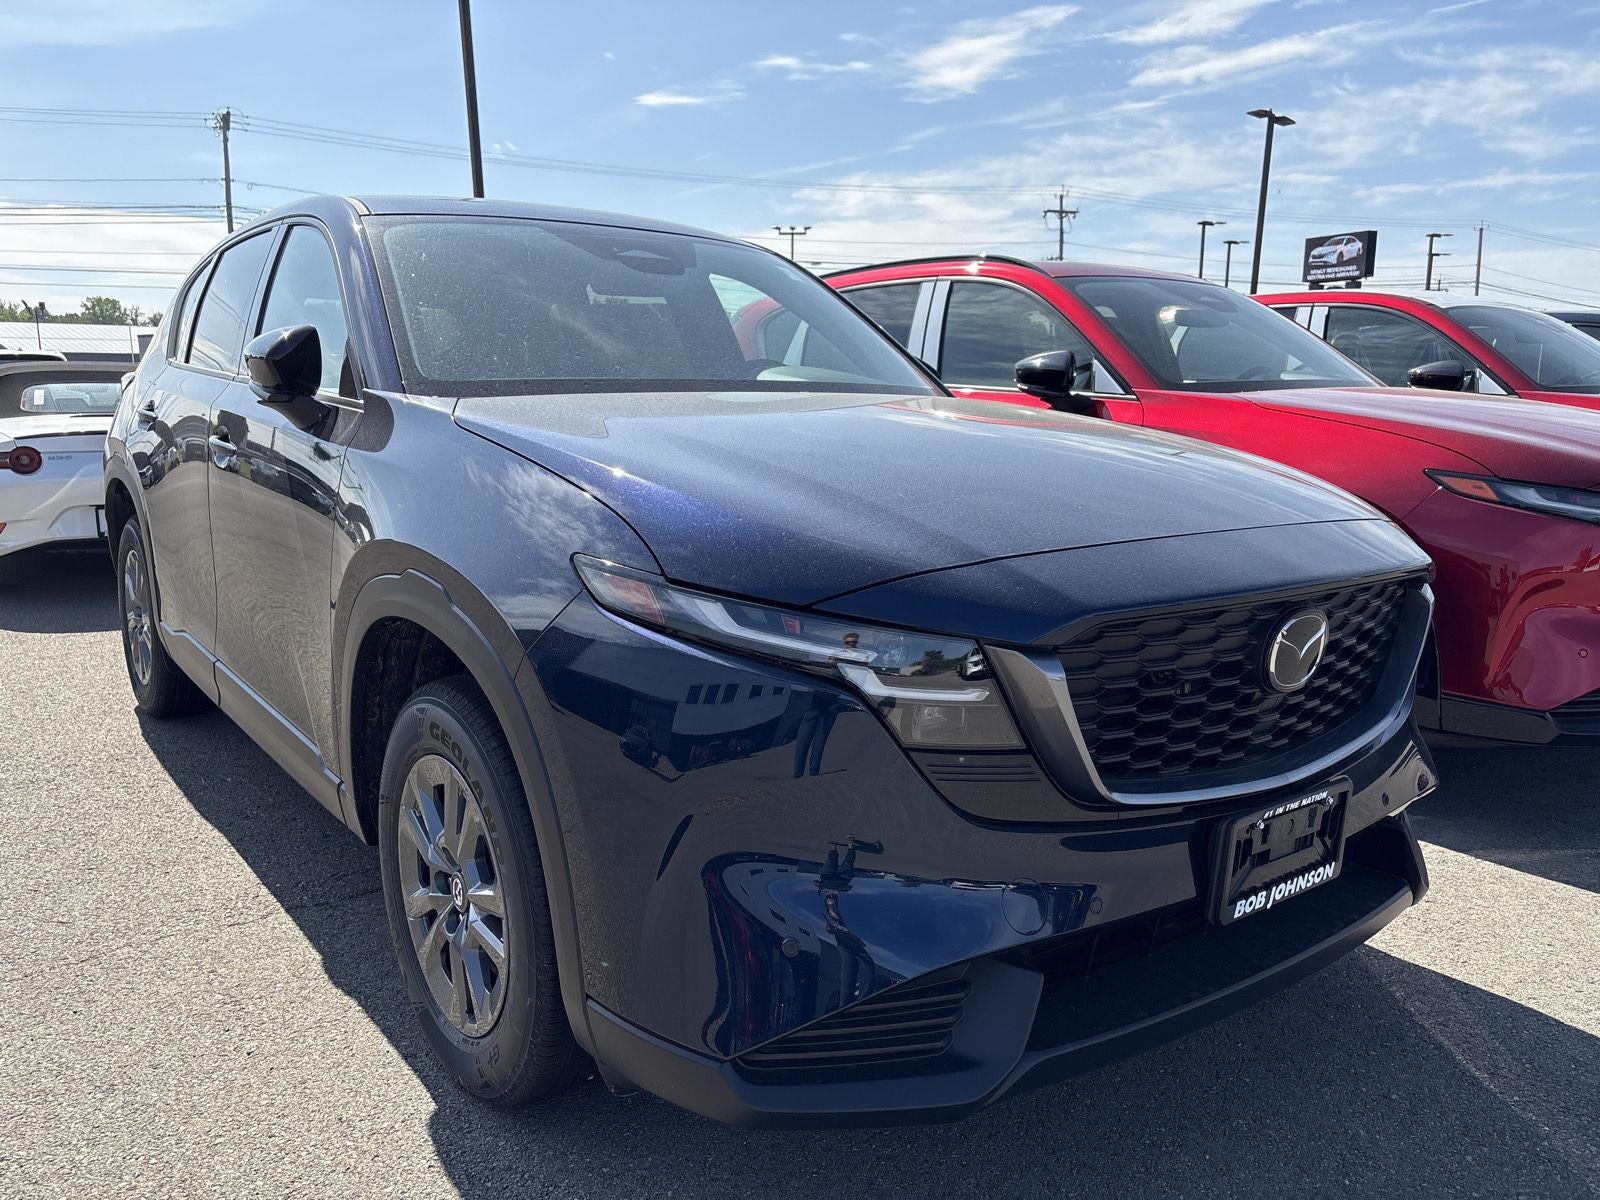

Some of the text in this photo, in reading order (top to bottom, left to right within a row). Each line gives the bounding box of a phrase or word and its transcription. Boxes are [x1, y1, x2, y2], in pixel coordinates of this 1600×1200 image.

[1275, 806, 1285, 815] IN
[1285, 800, 1301, 812] THE
[1301, 790, 1328, 807] NATION
[1233, 861, 1336, 919] BOB JOHNSON
